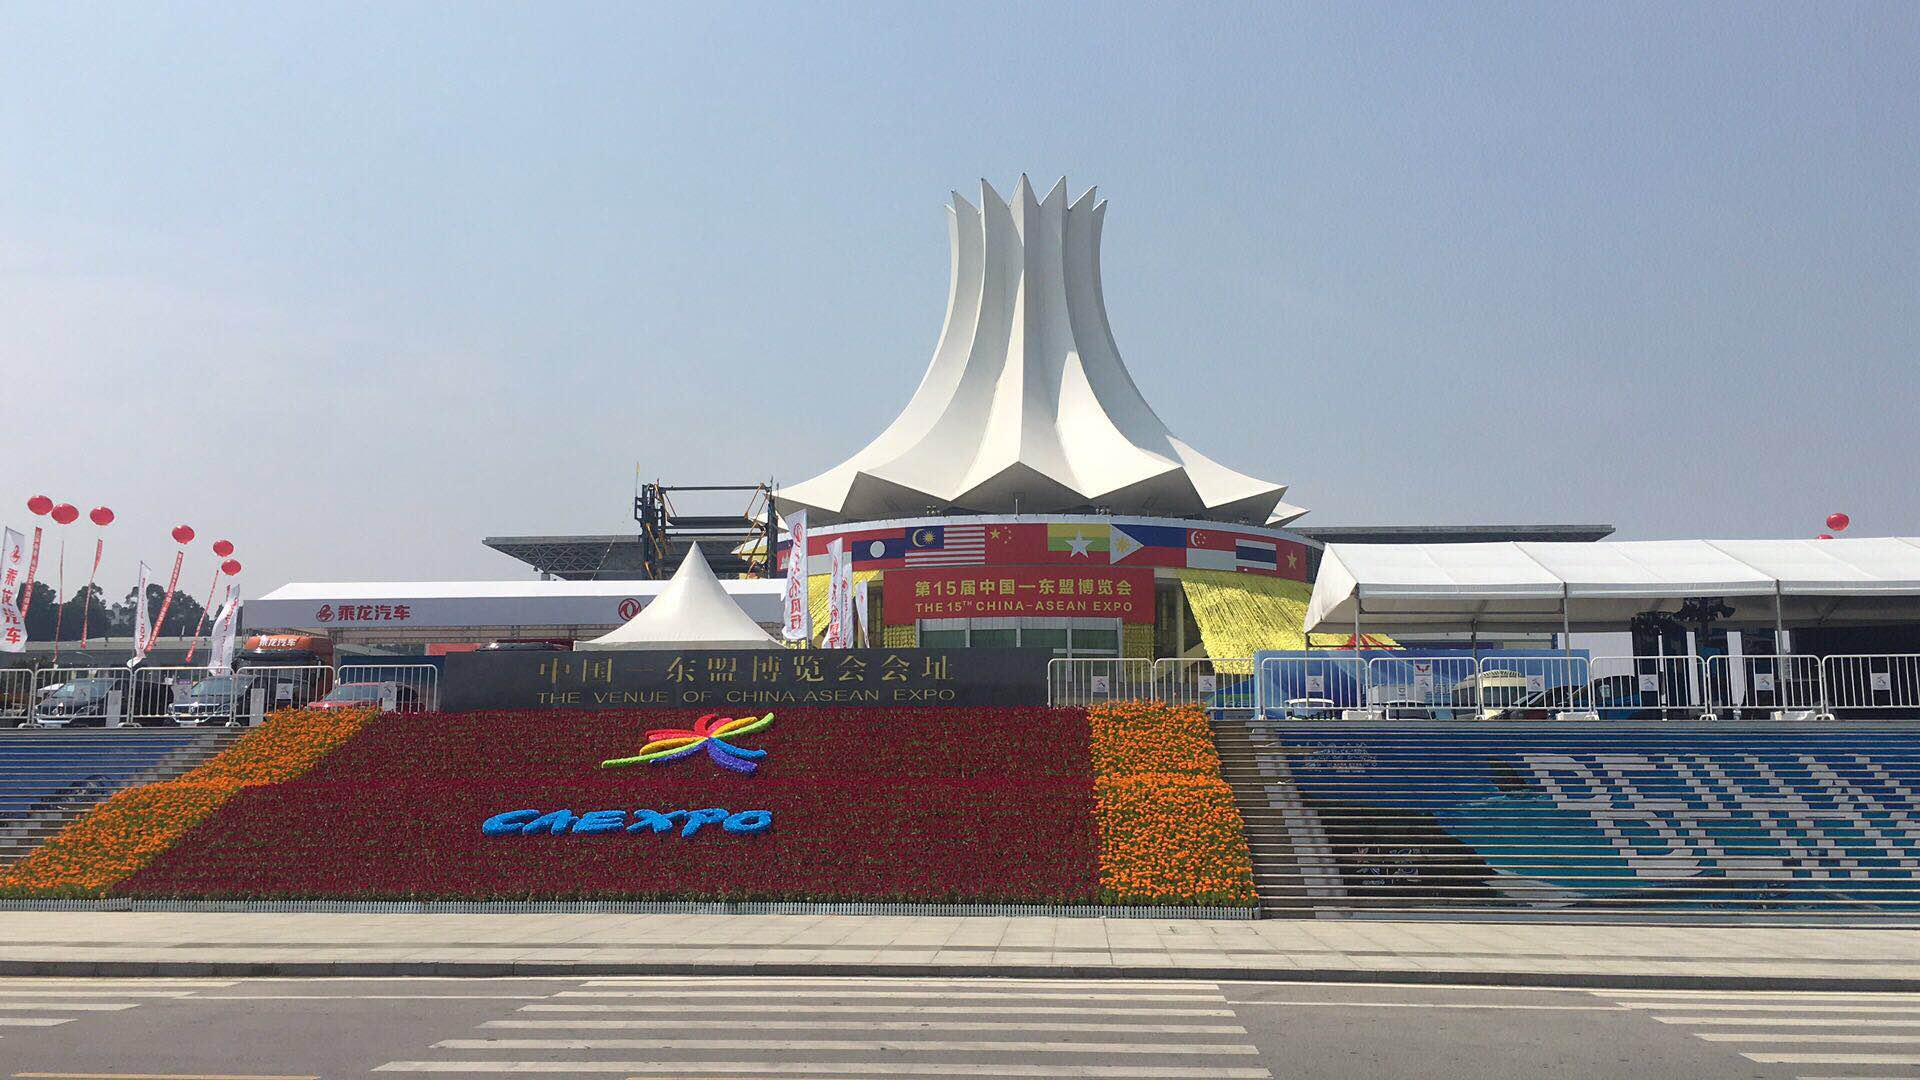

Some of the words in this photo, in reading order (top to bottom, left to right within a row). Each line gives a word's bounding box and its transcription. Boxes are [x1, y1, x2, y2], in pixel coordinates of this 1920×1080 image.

[338, 604, 411, 621] 乘龙汽车
[915, 602, 943, 613] THE
[976, 600, 1086, 612] CHINA-ASEAN
[1093, 601, 1133, 612] EXPO
[536, 692, 580, 704] THE
[594, 691, 668, 704] VENUE
[682, 691, 713, 703] OF
[893, 690, 956, 701] EXPO
[482, 808, 772, 838] CAEXPO
